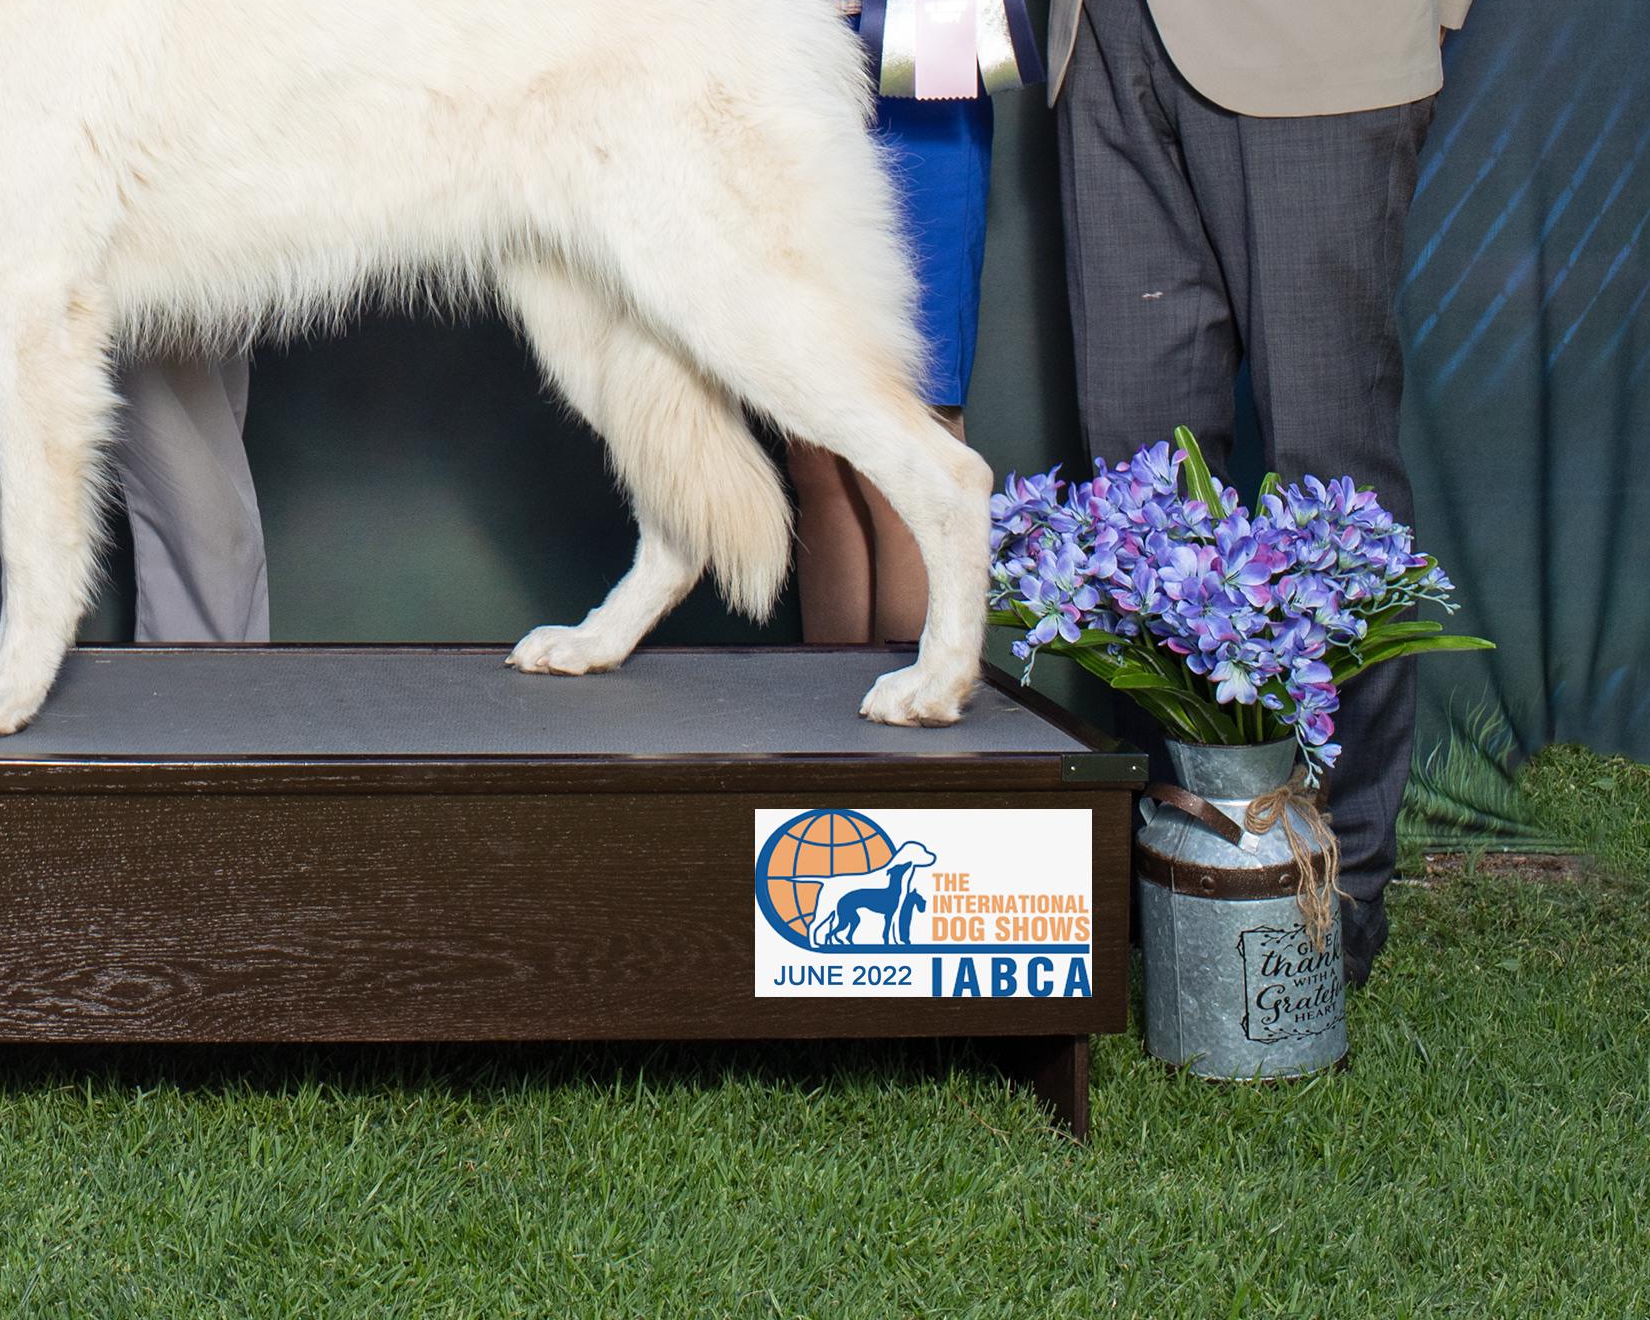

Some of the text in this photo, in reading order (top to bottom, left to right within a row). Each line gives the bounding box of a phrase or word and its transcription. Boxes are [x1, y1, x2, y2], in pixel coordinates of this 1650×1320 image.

[1261, 930, 1340, 977] thank
[1297, 932, 1332, 955] GIE
[1294, 967, 1336, 987] WITH A
[1295, 1001, 1336, 1023] HEART
